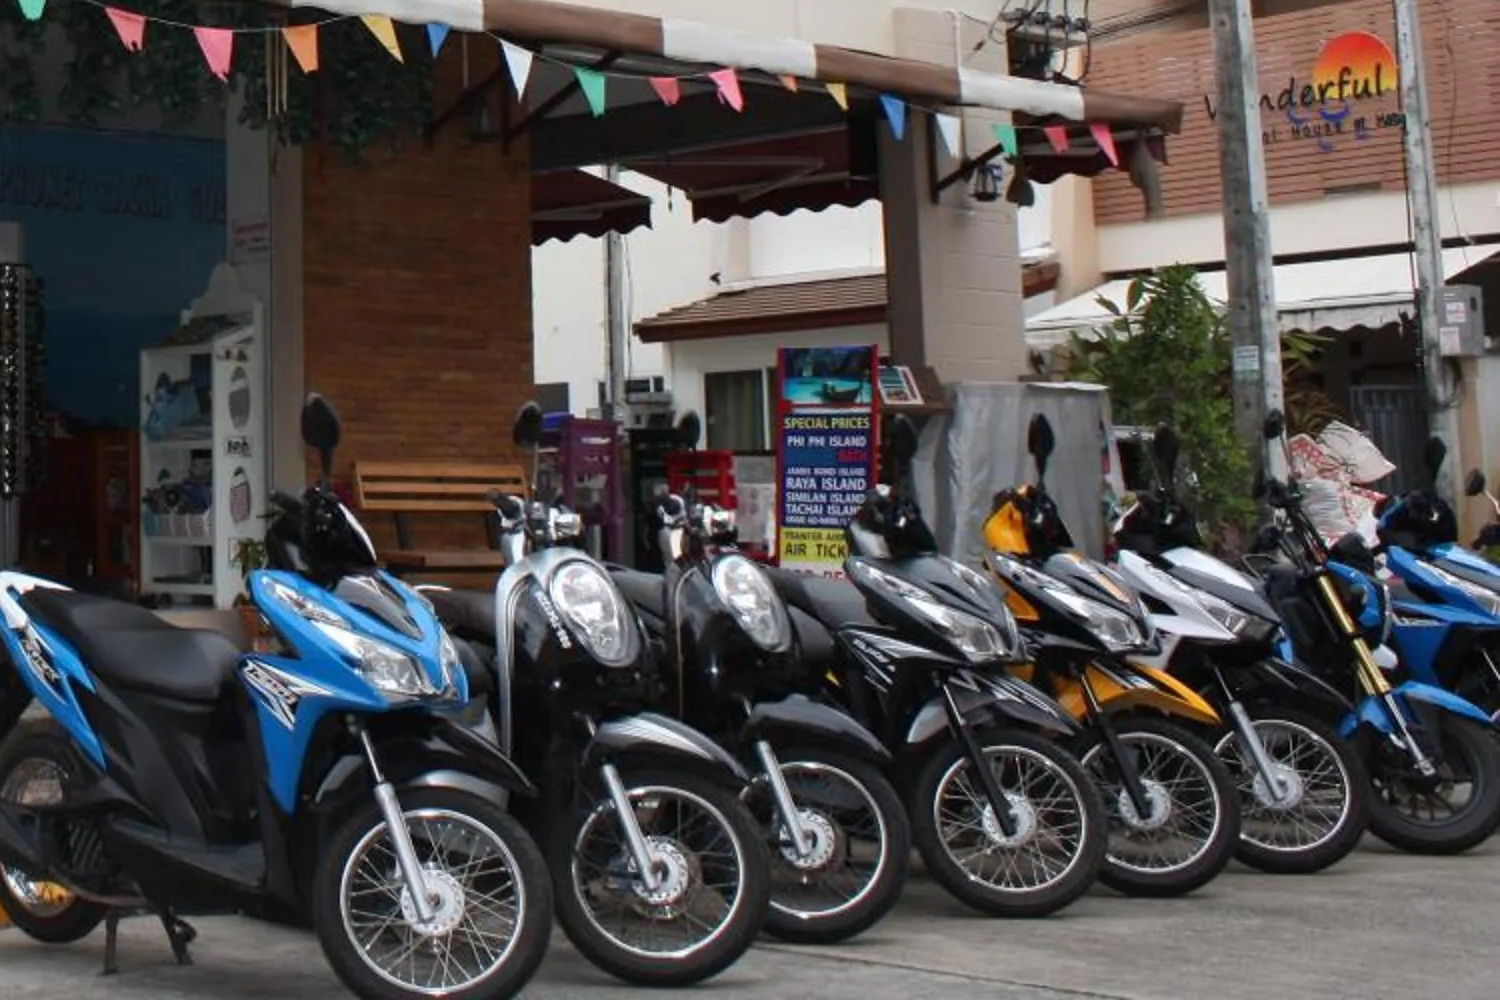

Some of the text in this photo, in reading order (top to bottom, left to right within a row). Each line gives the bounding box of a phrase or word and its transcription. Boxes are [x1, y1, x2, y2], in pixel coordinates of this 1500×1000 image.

[1204, 62, 1382, 121] nderful
[783, 416, 870, 429] SPECIAL PRICES
[787, 435, 867, 447] PHI PHI ISLAND
[785, 477, 867, 490] RAYA ISLAND
[786, 492, 865, 504] SIMILAN ISLAND
[785, 503, 859, 516] TACHAI ISLAN
[785, 542, 846, 558] AIR TICK
